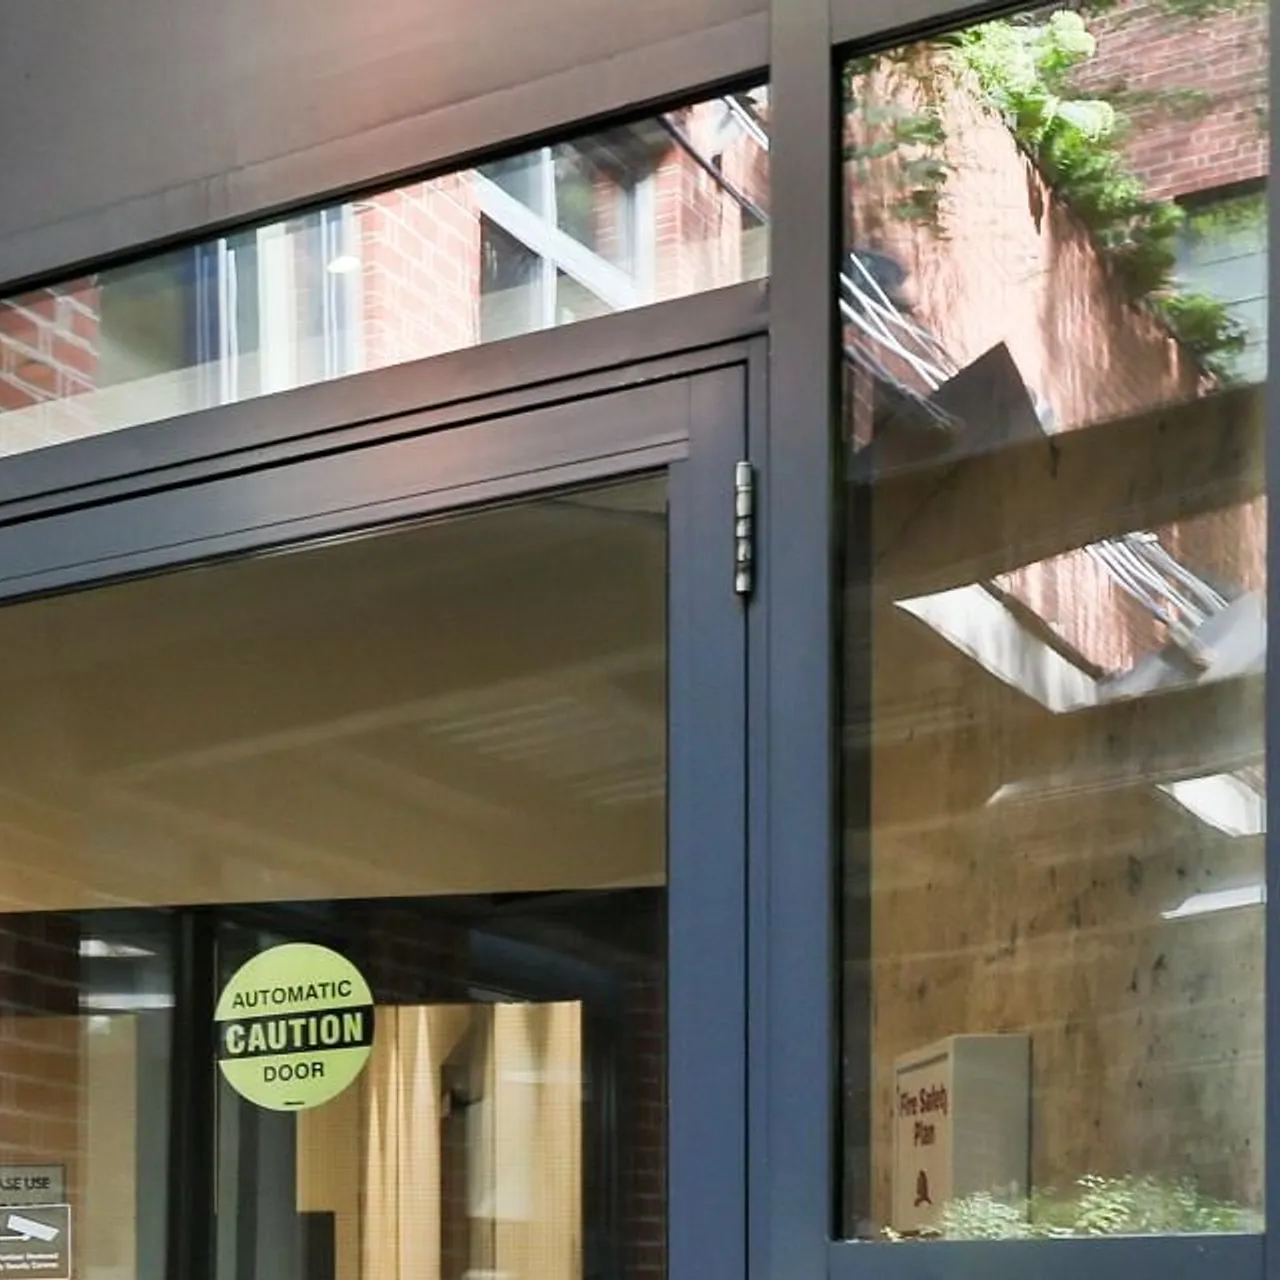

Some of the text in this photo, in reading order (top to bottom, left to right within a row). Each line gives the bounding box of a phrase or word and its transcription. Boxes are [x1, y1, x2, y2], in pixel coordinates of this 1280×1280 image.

[232, 980, 352, 1009] AUTOMATIC
[225, 1012, 364, 1054] CAUTION
[263, 1062, 325, 1083] DOOR
[914, 1121, 936, 1147] Plan
[24, 1177, 50, 1190] USE
